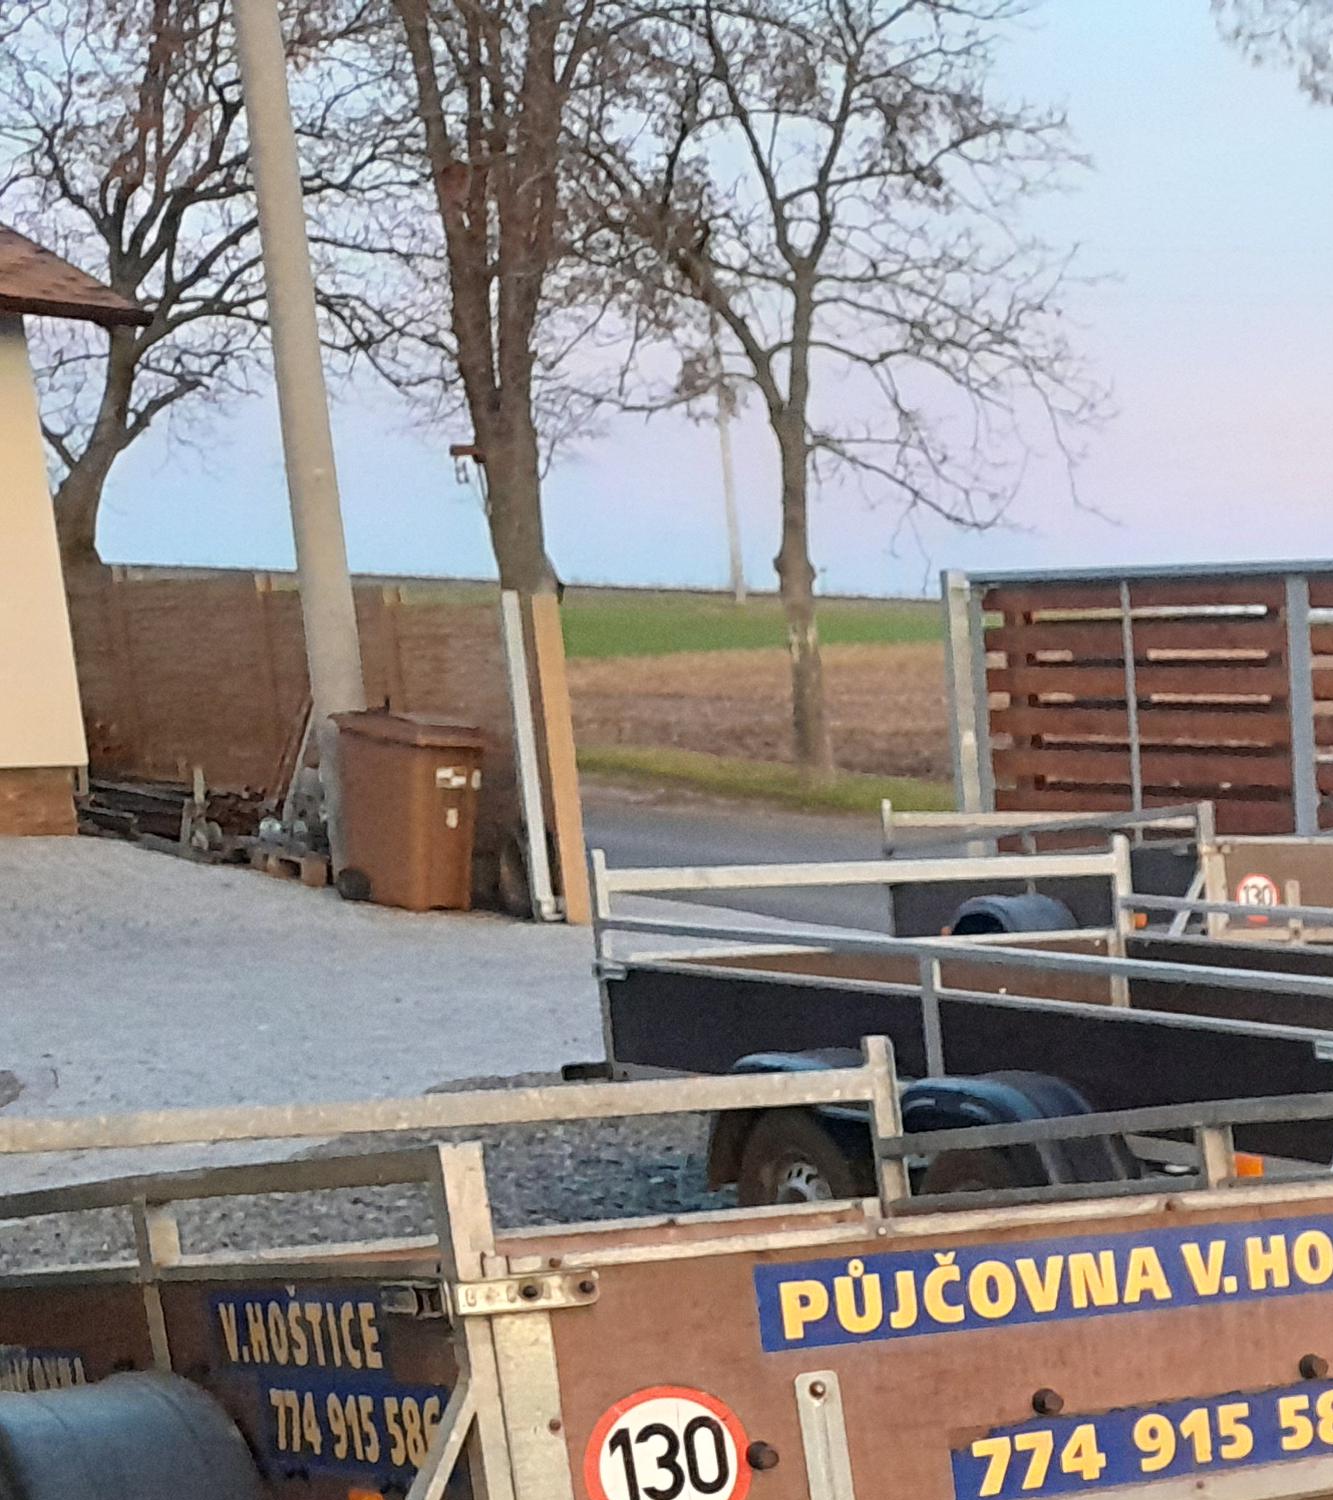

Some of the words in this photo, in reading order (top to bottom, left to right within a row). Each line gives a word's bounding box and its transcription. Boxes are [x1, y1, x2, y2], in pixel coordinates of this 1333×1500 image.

[218, 1284, 383, 1369] V.HOŠTICE
[779, 1246, 1172, 1340] PŮJČOVNA
[269, 1388, 321, 1455] 774
[327, 1392, 381, 1463] 915
[972, 1424, 1106, 1497] 774
[1134, 1403, 1254, 1472] 915
